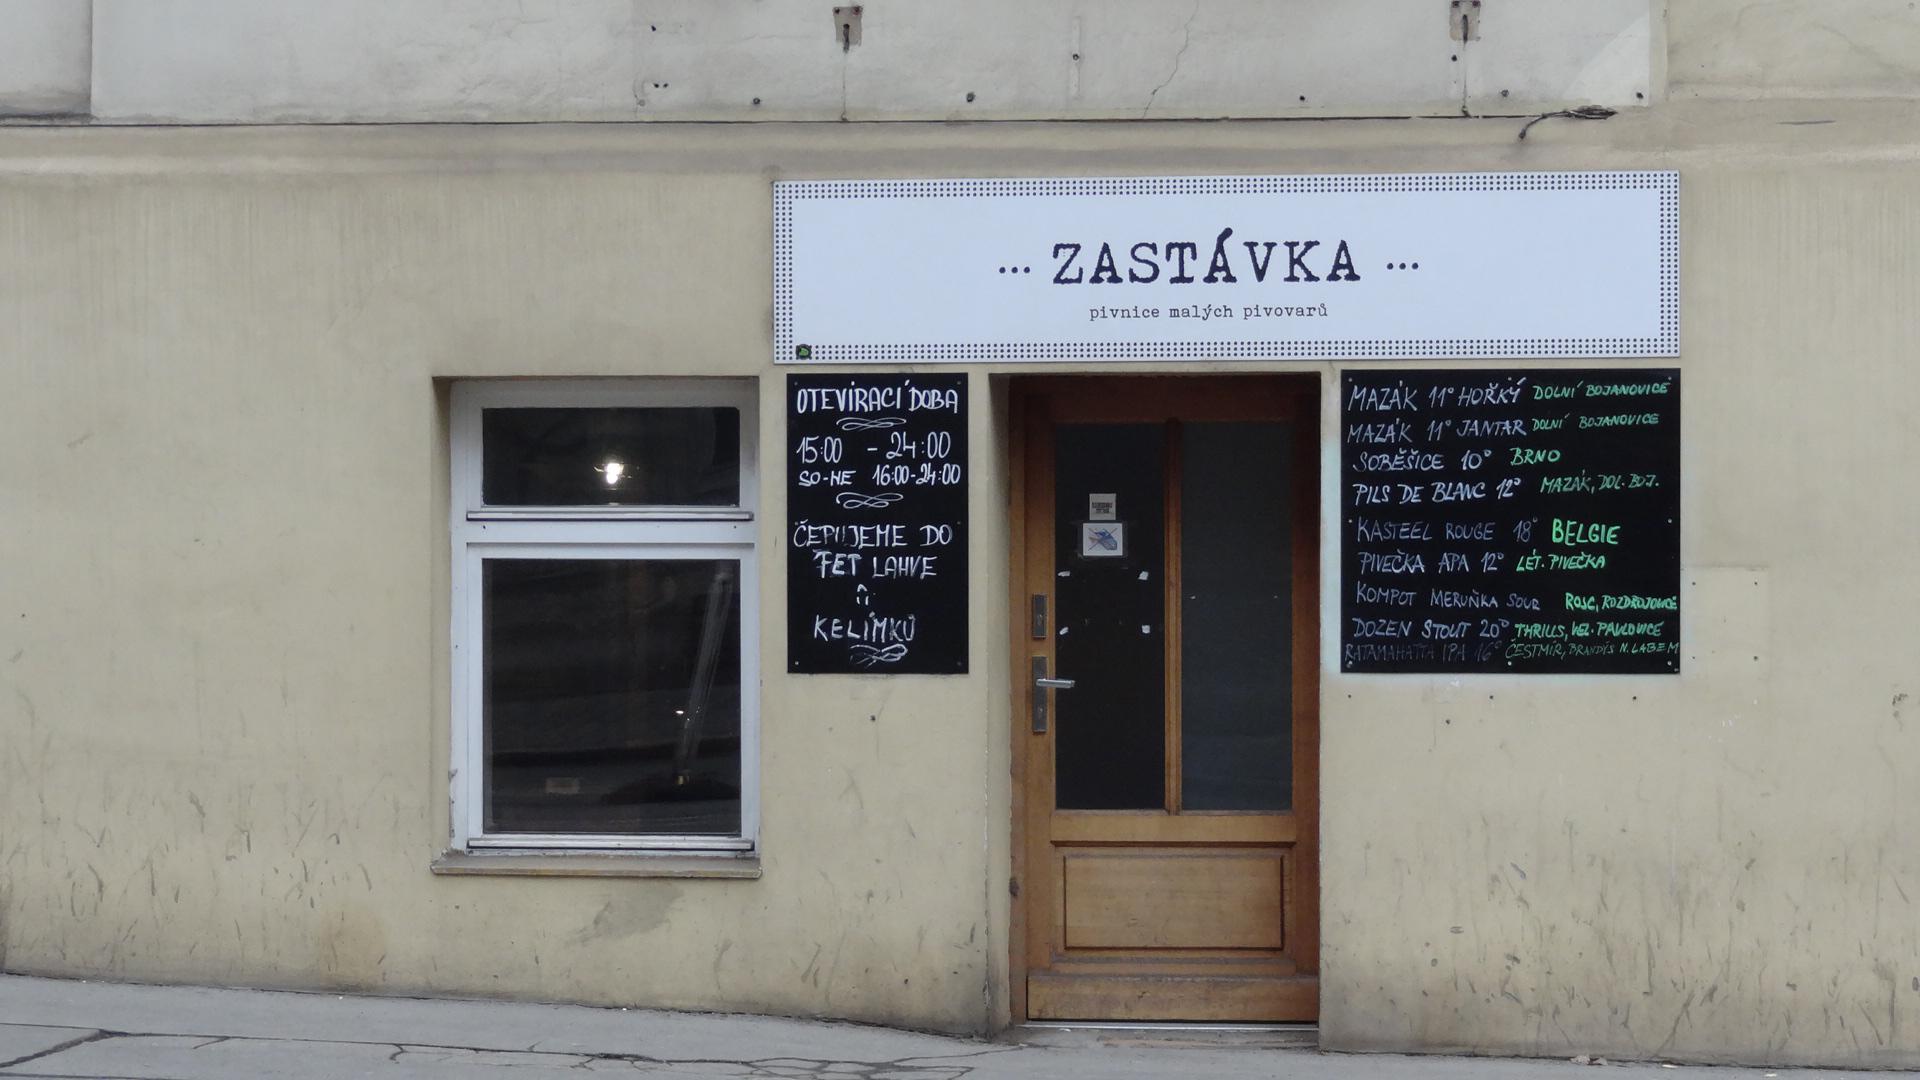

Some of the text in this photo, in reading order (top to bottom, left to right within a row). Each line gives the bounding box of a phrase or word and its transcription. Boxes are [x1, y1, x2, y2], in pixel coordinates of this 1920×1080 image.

[1052, 227, 1361, 286] ZASTÁVKA
[1089, 302, 1328, 322] pivnice malých pivovarů
[797, 379, 959, 414] OTEVÍRACÍ DOBA
[1347, 377, 1671, 412] MAZÁK 11° HOŘKÝ DOLNÍ BOJANOVICE
[1347, 412, 1661, 444] MAZÁK 11° JANTAR DOLNÍ BOJANOVICE
[796, 435, 843, 464] 15:00
[886, 431, 951, 460] 24:00
[1352, 447, 1561, 472] SOBĚŠICE 10° BRNO
[1352, 483, 1391, 506] PILS
[1397, 483, 1424, 505] DE
[1431, 481, 1487, 502] BLANC
[920, 523, 953, 547] DO
[1357, 515, 1432, 543] KASTEEL
[1445, 521, 1496, 541] ROUGE
[1552, 518, 1621, 546] BELGIE
[872, 555, 938, 580] LAHVE
[1358, 548, 1425, 575] PIVEČKA
[1438, 552, 1469, 574] APA
[1480, 551, 1505, 573] 12°
[1548, 551, 1606, 570] PIVEČKA
[1356, 580, 1417, 606] KOMPOT
[1430, 588, 1498, 609] MERUŇKA
[1506, 592, 1541, 611] SOUR
[1352, 617, 1412, 638] DOZEN
[1421, 619, 1471, 640] STOUT
[1596, 621, 1664, 637] PAVLOVICE
[1631, 642, 1679, 655] LABEM
